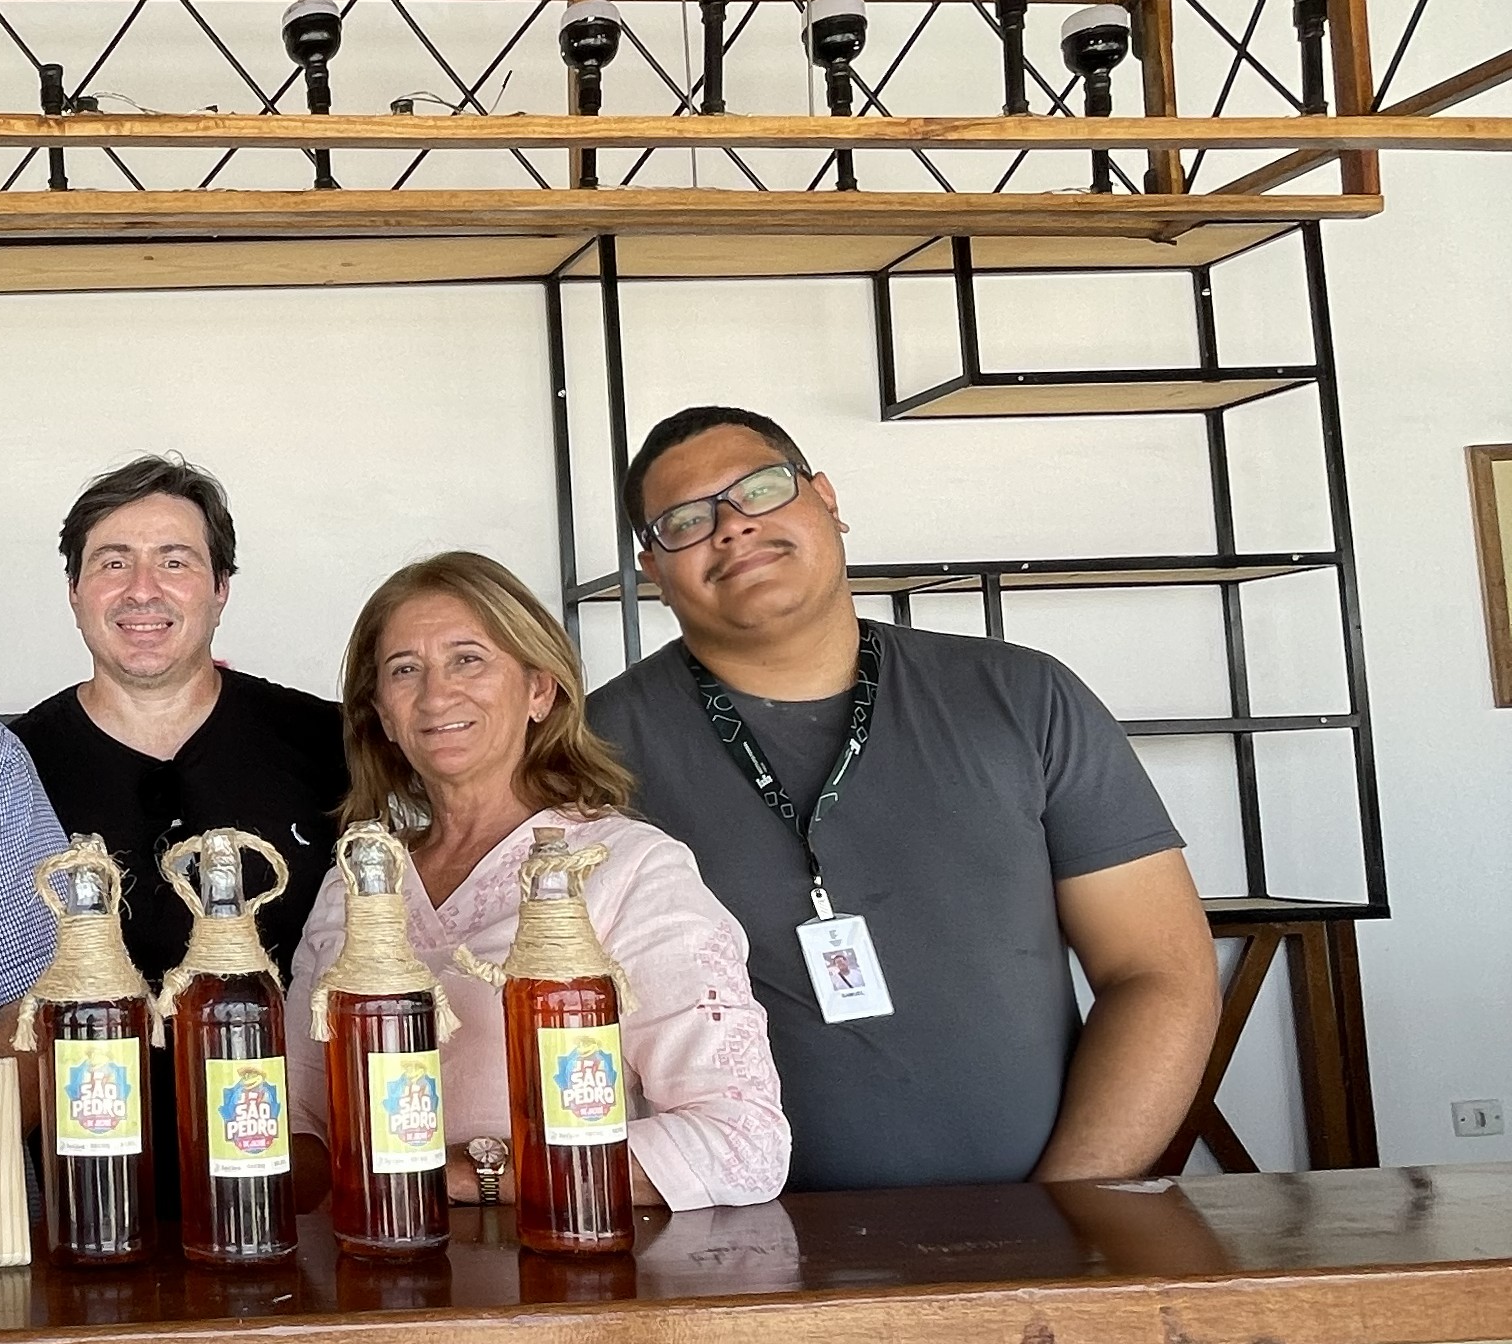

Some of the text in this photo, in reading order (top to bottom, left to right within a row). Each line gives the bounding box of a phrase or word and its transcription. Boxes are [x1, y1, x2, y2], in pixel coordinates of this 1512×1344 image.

[80, 1071, 117, 1099] SÃO
[570, 1060, 607, 1089] SÃO
[71, 1097, 126, 1118] PEDRO
[235, 1092, 271, 1121] SÃO
[398, 1084, 432, 1115] SÃO
[562, 1086, 615, 1108] PEDRO
[226, 1118, 278, 1139] PEDRO
[390, 1111, 437, 1135] PEDRO
